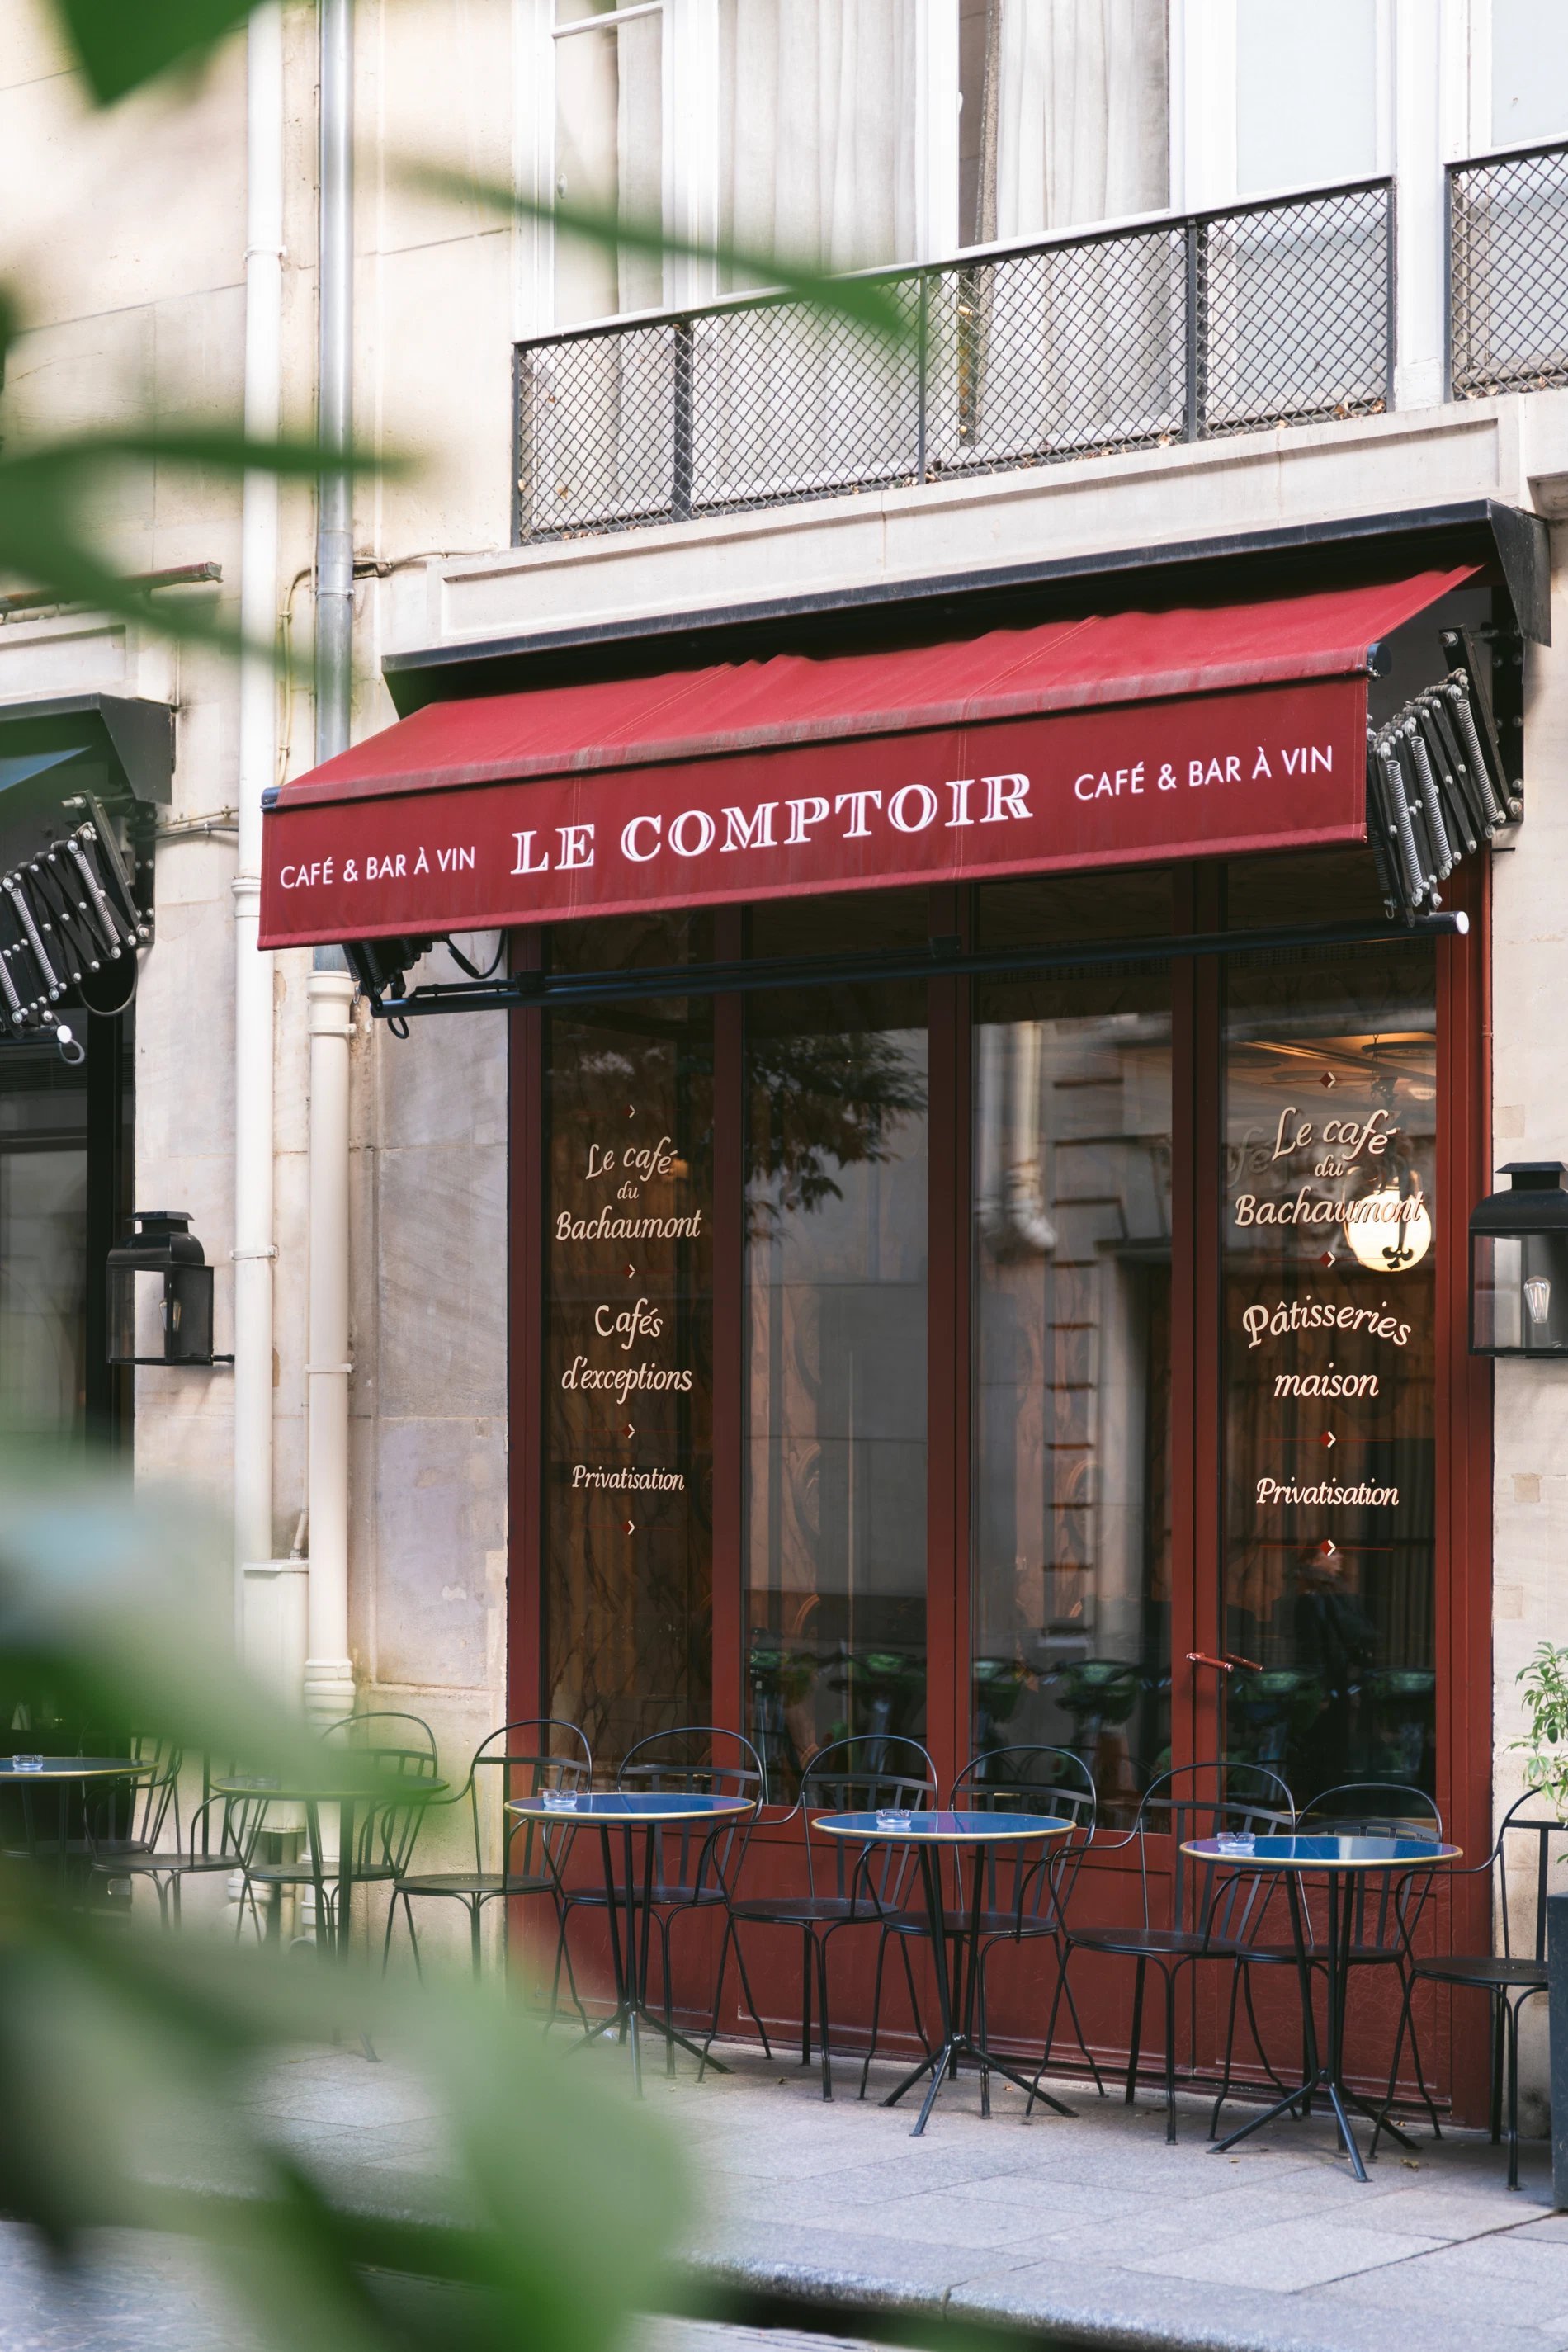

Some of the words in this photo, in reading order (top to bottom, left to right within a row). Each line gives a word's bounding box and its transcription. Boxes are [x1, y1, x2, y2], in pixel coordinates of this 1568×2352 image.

[1074, 761, 1145, 801] CAFÉ
[1157, 763, 1177, 791] &
[1189, 756, 1241, 787] BAR
[1251, 746, 1272, 780] À
[1281, 745, 1332, 775] VIN
[510, 824, 595, 875] LE
[621, 773, 1033, 862] COMPTOIR
[280, 856, 333, 889] CAFÉ
[342, 858, 358, 882] &
[366, 854, 406, 880] BAR
[413, 846, 430, 875] À
[437, 846, 475, 872] VIN
[1271, 1106, 1312, 1161] Le
[1322, 1108, 1398, 1161] café
[585, 1143, 615, 1180] Le
[623, 1136, 678, 1182] café
[1315, 1154, 1344, 1178] du
[616, 1180, 640, 1200] du
[1235, 1185, 1424, 1226] Bachaumont
[555, 1205, 702, 1240] Bachaumont
[594, 1297, 664, 1350] Cafés
[1242, 1295, 1412, 1349] Pâtisseries
[561, 1355, 692, 1405] d'exceptions
[1273, 1362, 1380, 1397] maison
[572, 1464, 685, 1490] Privatisation
[1256, 1476, 1400, 1506] Privatisation
